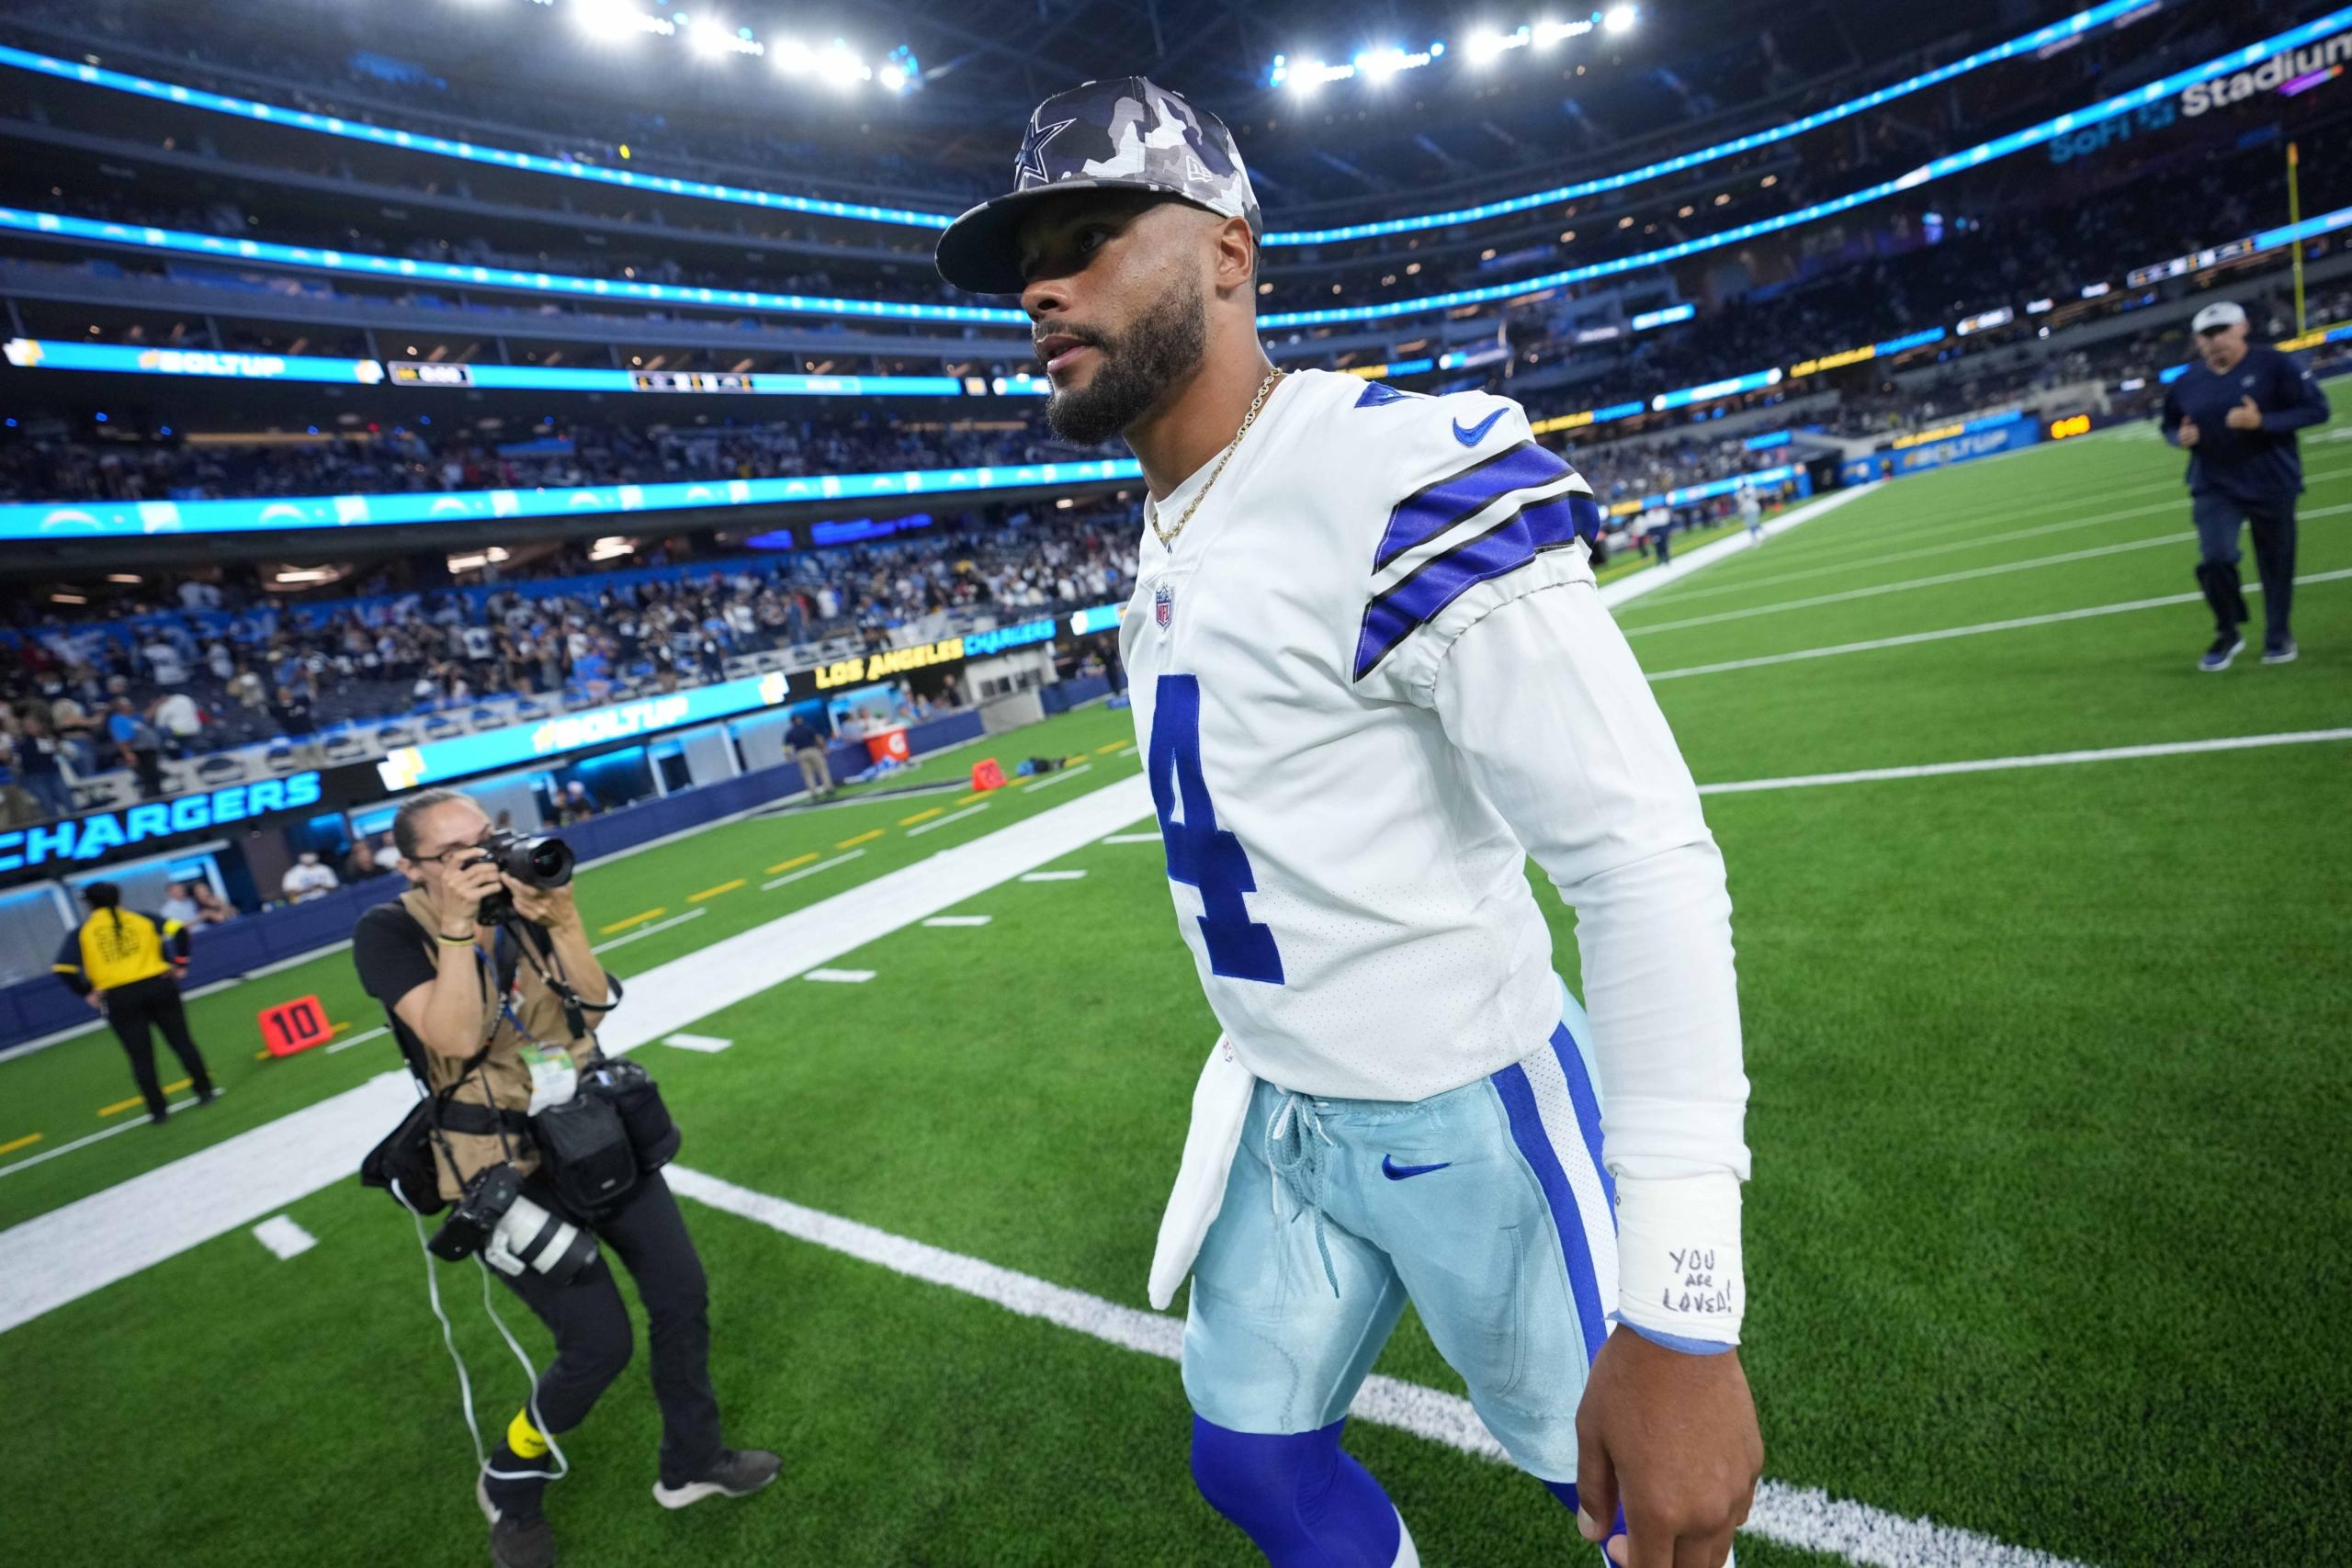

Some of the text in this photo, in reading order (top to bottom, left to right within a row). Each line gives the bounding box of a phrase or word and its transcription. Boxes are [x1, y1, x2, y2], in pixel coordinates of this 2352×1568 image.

[815, 618, 1057, 689] LOS ANGELES CHARGERS
[1148, 673, 1285, 986] 4
[271, 1004, 320, 1044] 10
[1668, 1248, 1714, 1274] YOU
